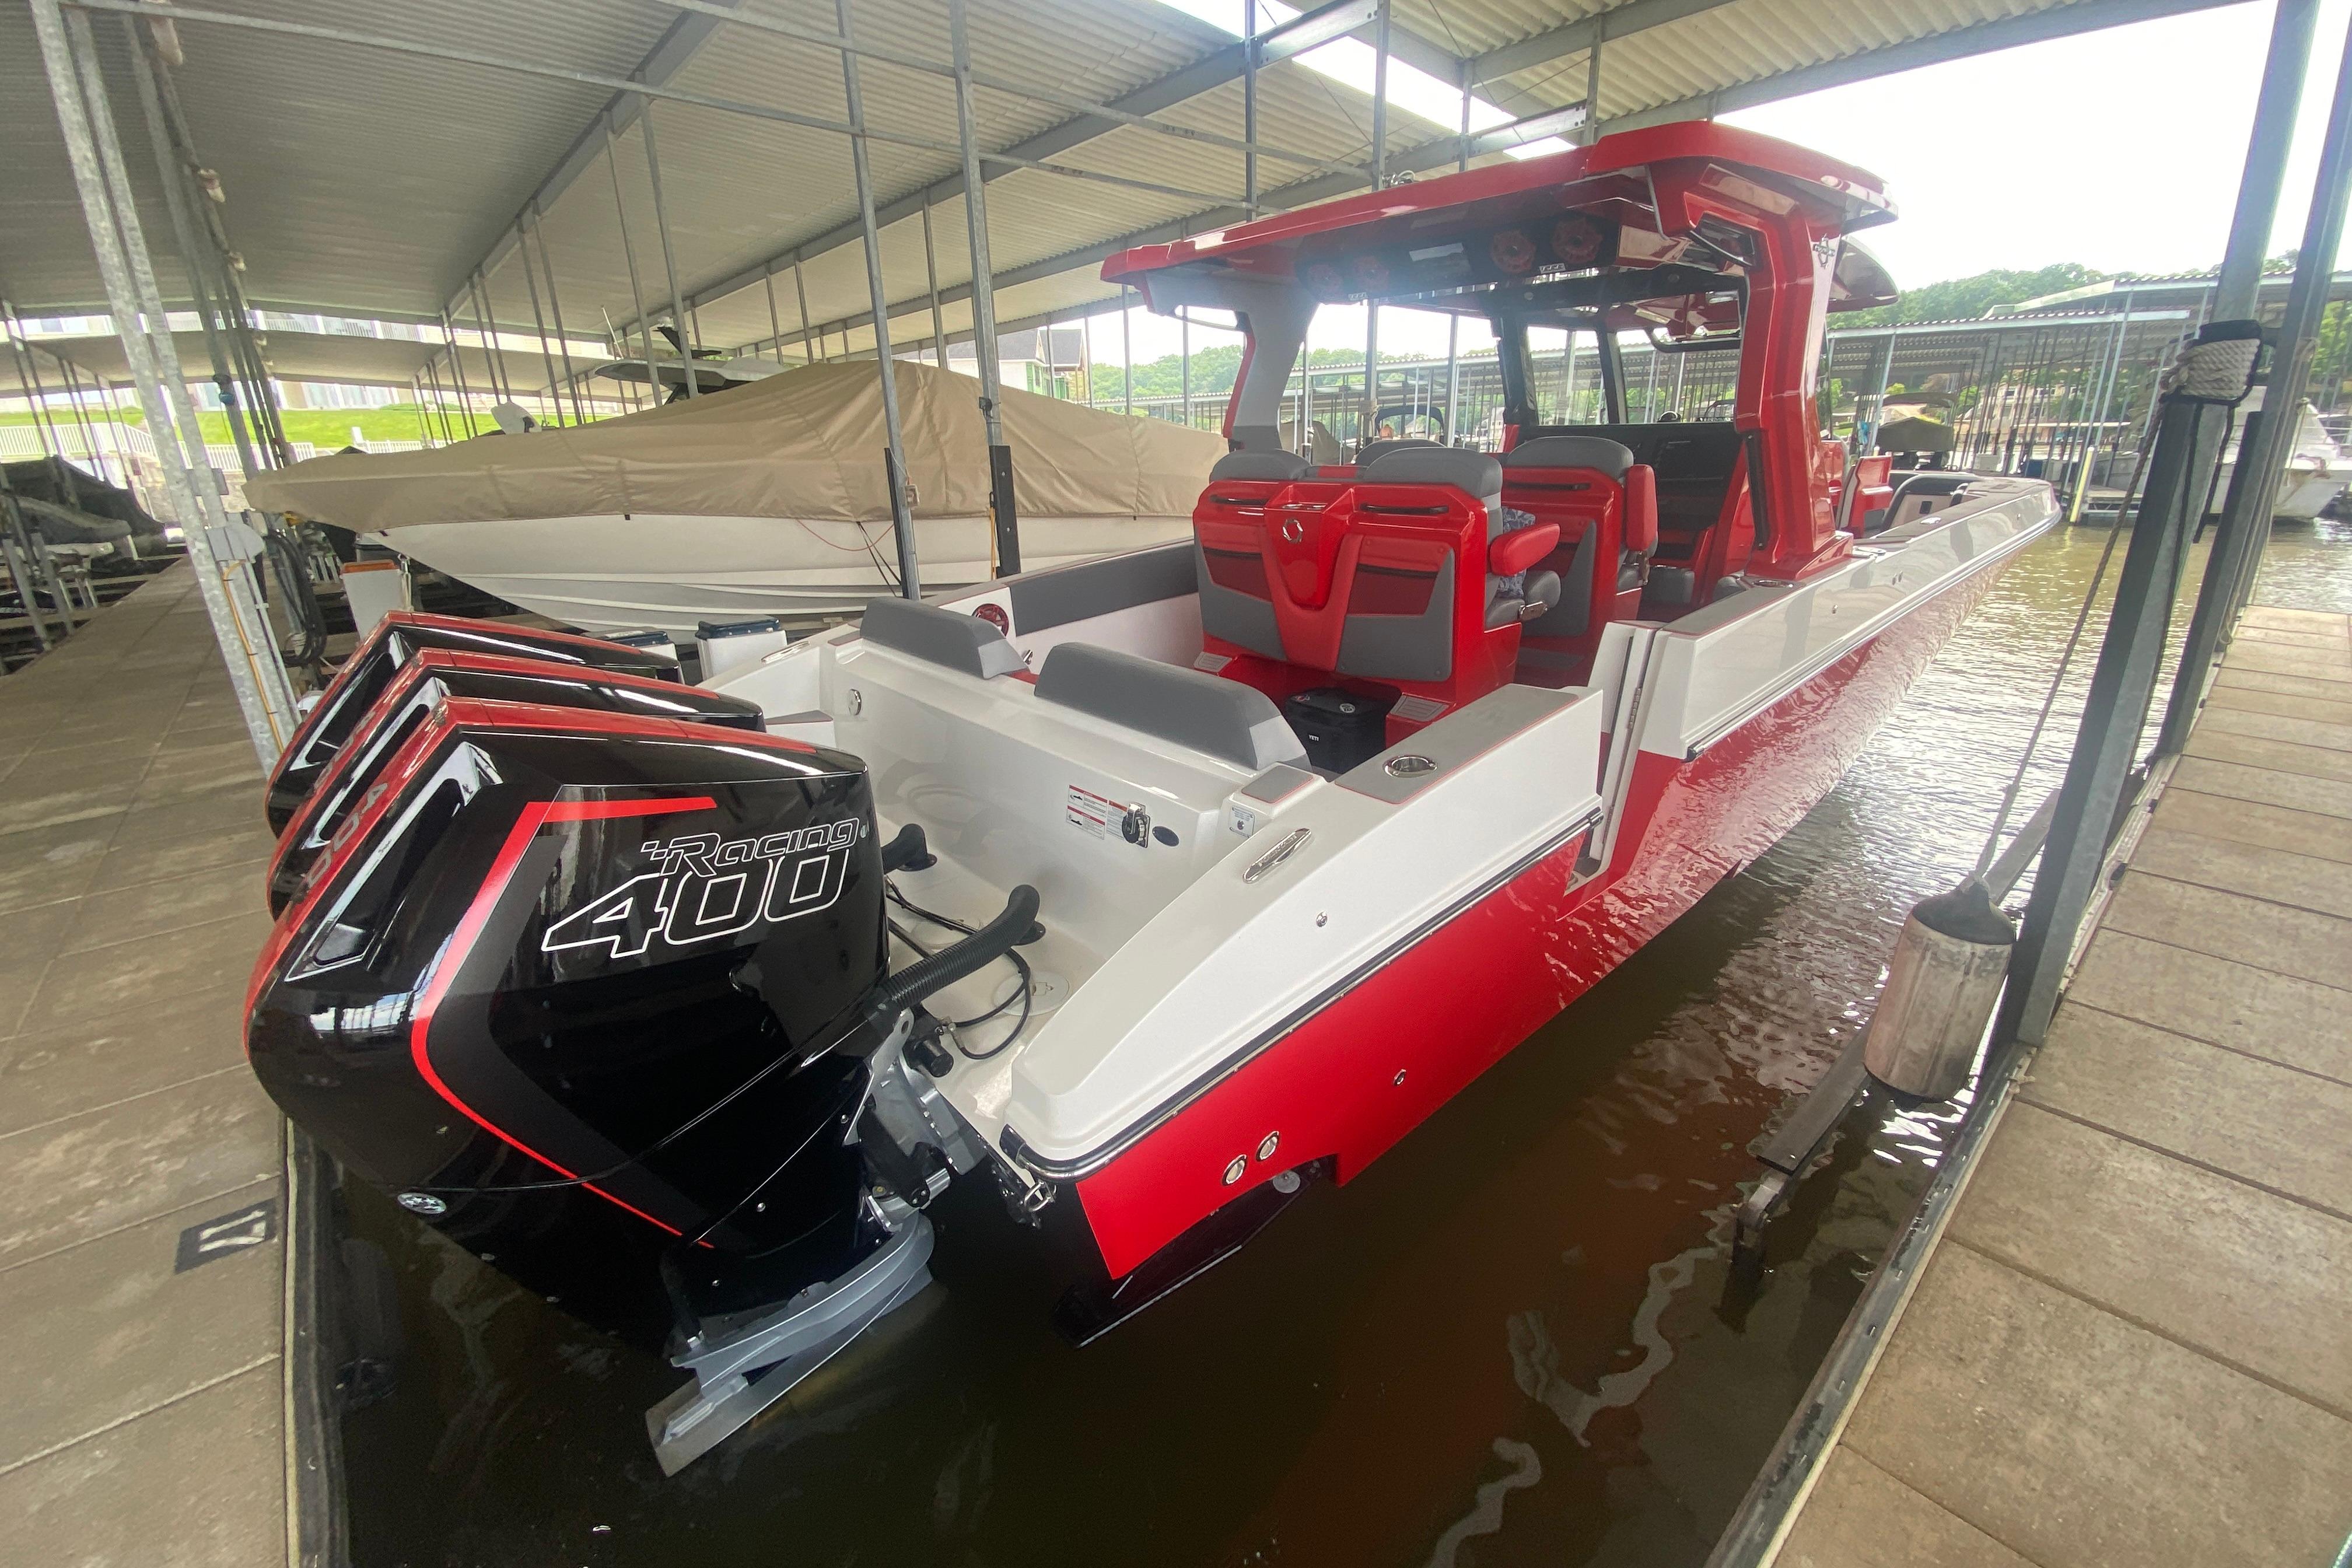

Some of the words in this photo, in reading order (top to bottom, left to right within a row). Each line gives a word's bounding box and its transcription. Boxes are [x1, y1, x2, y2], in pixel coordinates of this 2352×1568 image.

[659, 817, 860, 877] Racing
[541, 848, 850, 958] 400
[198, 1210, 267, 1252] 17
